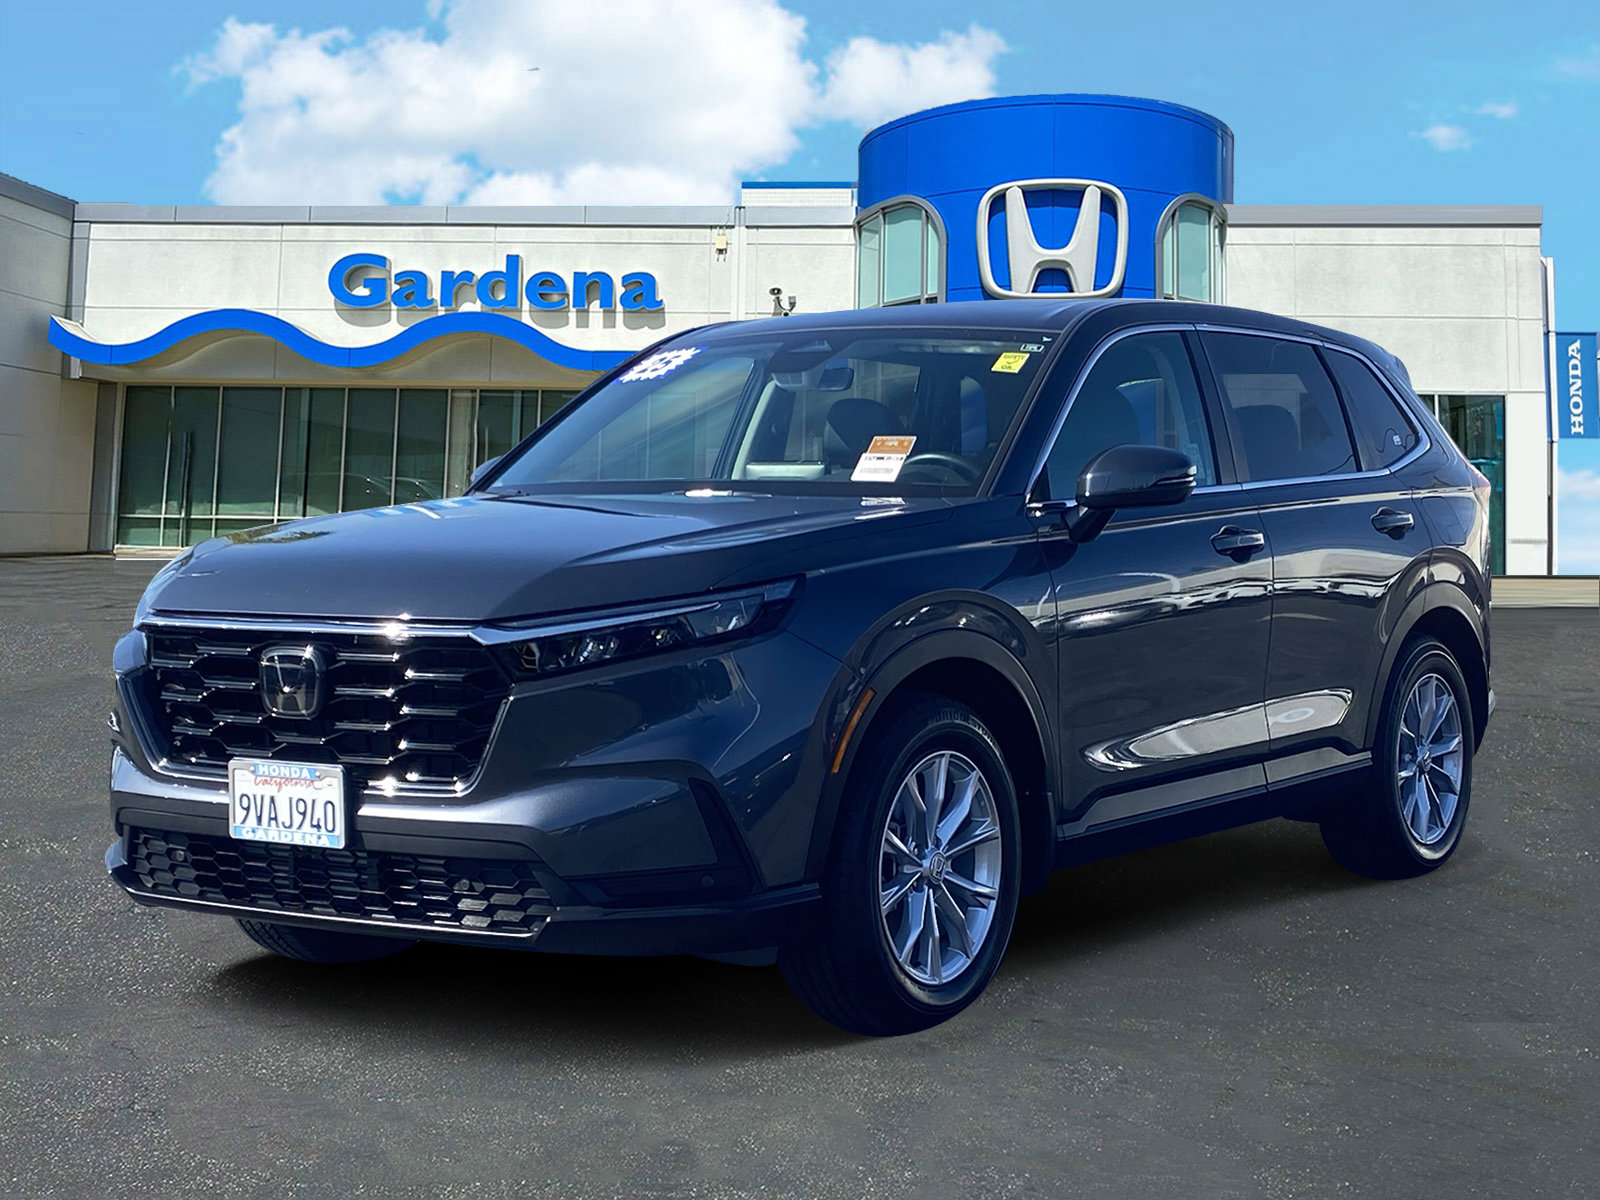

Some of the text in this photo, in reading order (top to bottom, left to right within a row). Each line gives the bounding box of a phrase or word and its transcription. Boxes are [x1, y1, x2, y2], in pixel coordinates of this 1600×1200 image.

[328, 252, 663, 309] Gardena
[1567, 338, 1584, 435] HONDA
[259, 764, 312, 780] HONDA
[239, 792, 336, 834] 9VAJ940
